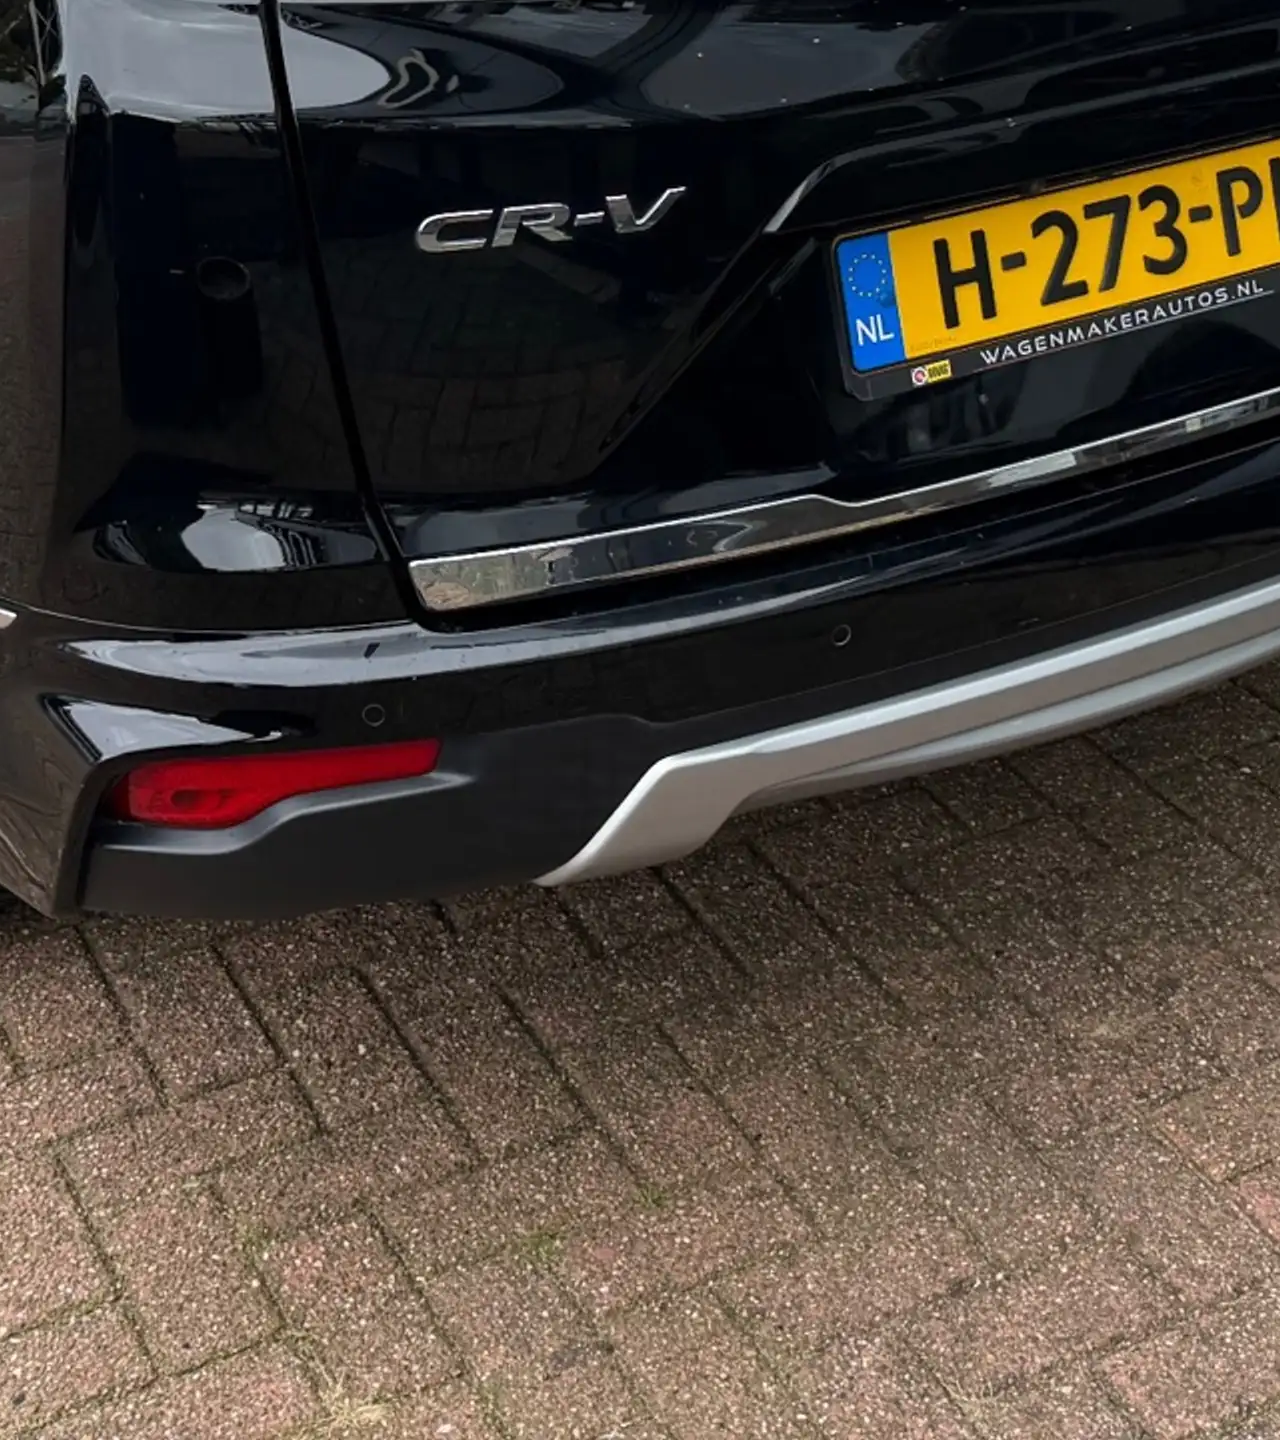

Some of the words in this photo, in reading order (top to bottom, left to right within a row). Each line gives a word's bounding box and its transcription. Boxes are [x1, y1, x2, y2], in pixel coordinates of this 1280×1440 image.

[415, 186, 688, 254] CR-V
[855, 313, 896, 347] NL
[979, 276, 1265, 367] WAGENMAKERAUTOS.NL
